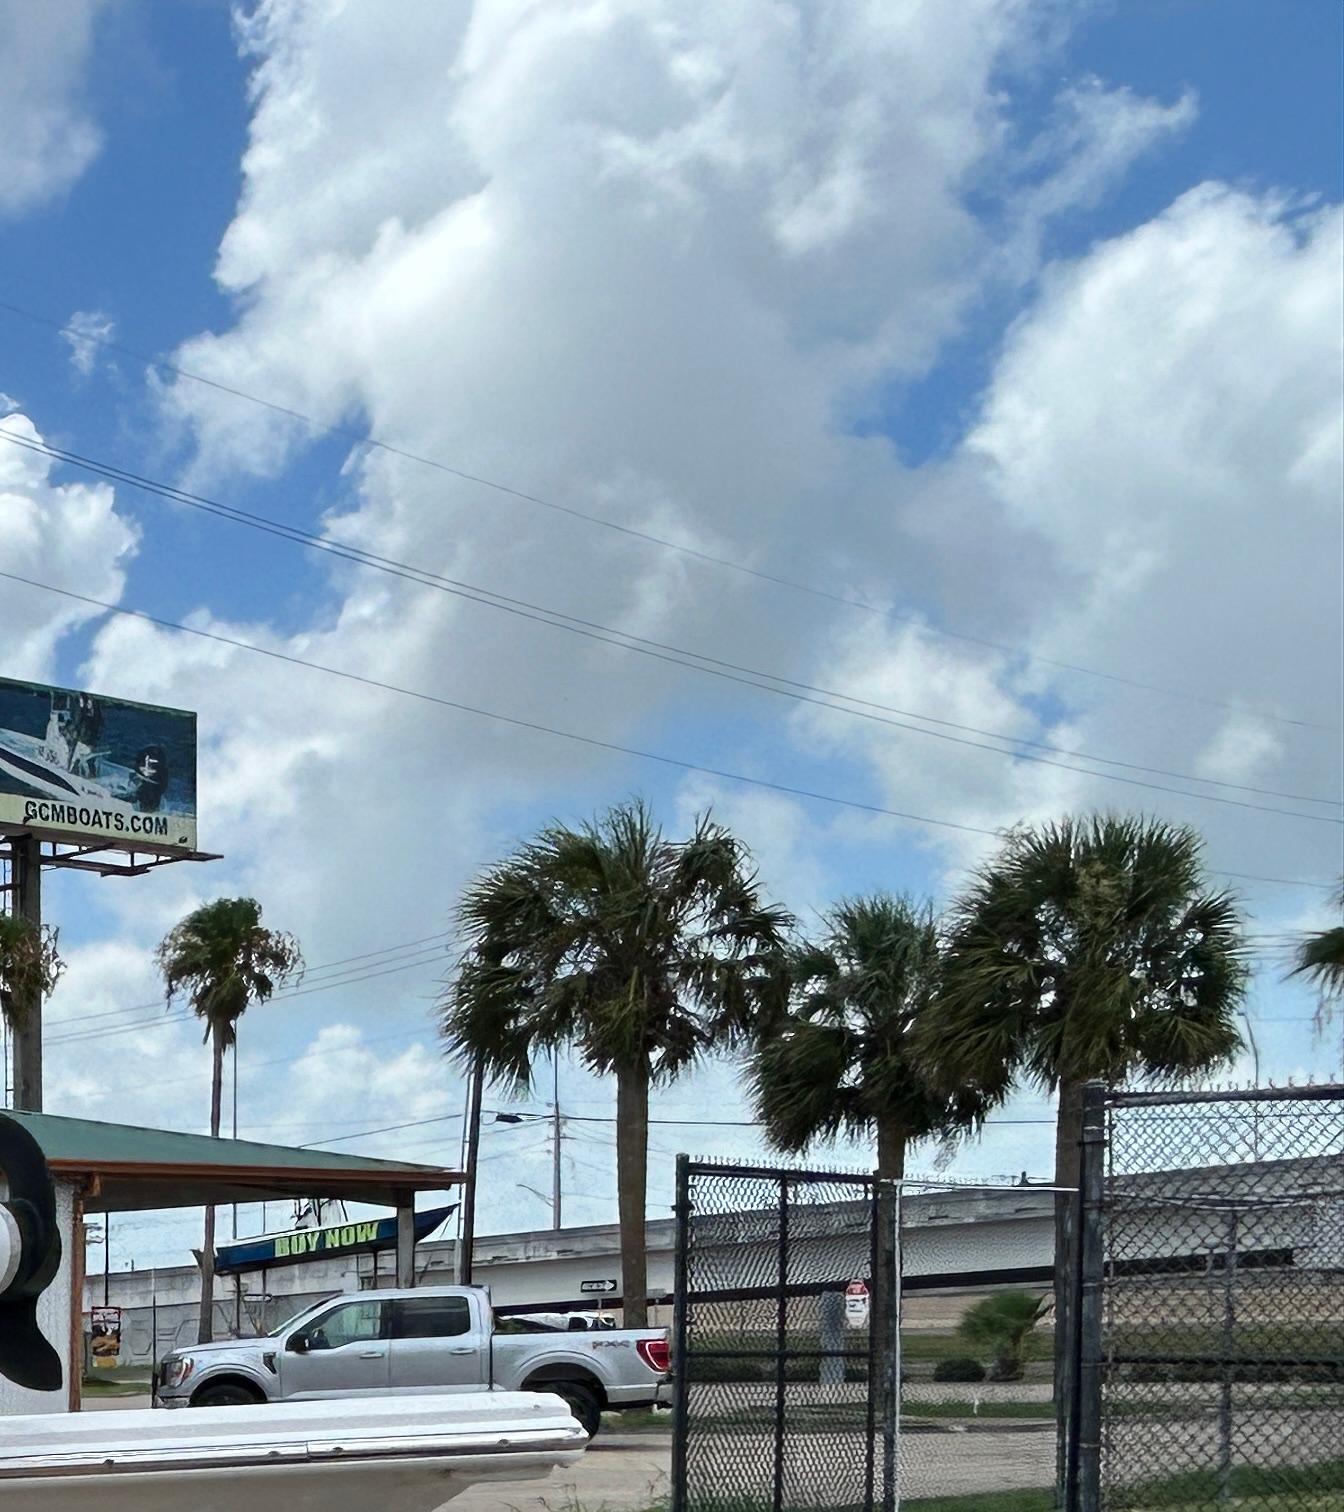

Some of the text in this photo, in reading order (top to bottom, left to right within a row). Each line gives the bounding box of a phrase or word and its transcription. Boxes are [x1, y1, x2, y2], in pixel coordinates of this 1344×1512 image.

[24, 800, 168, 836] GCMBOATS.COM
[275, 1221, 379, 1258] BUY NOW
